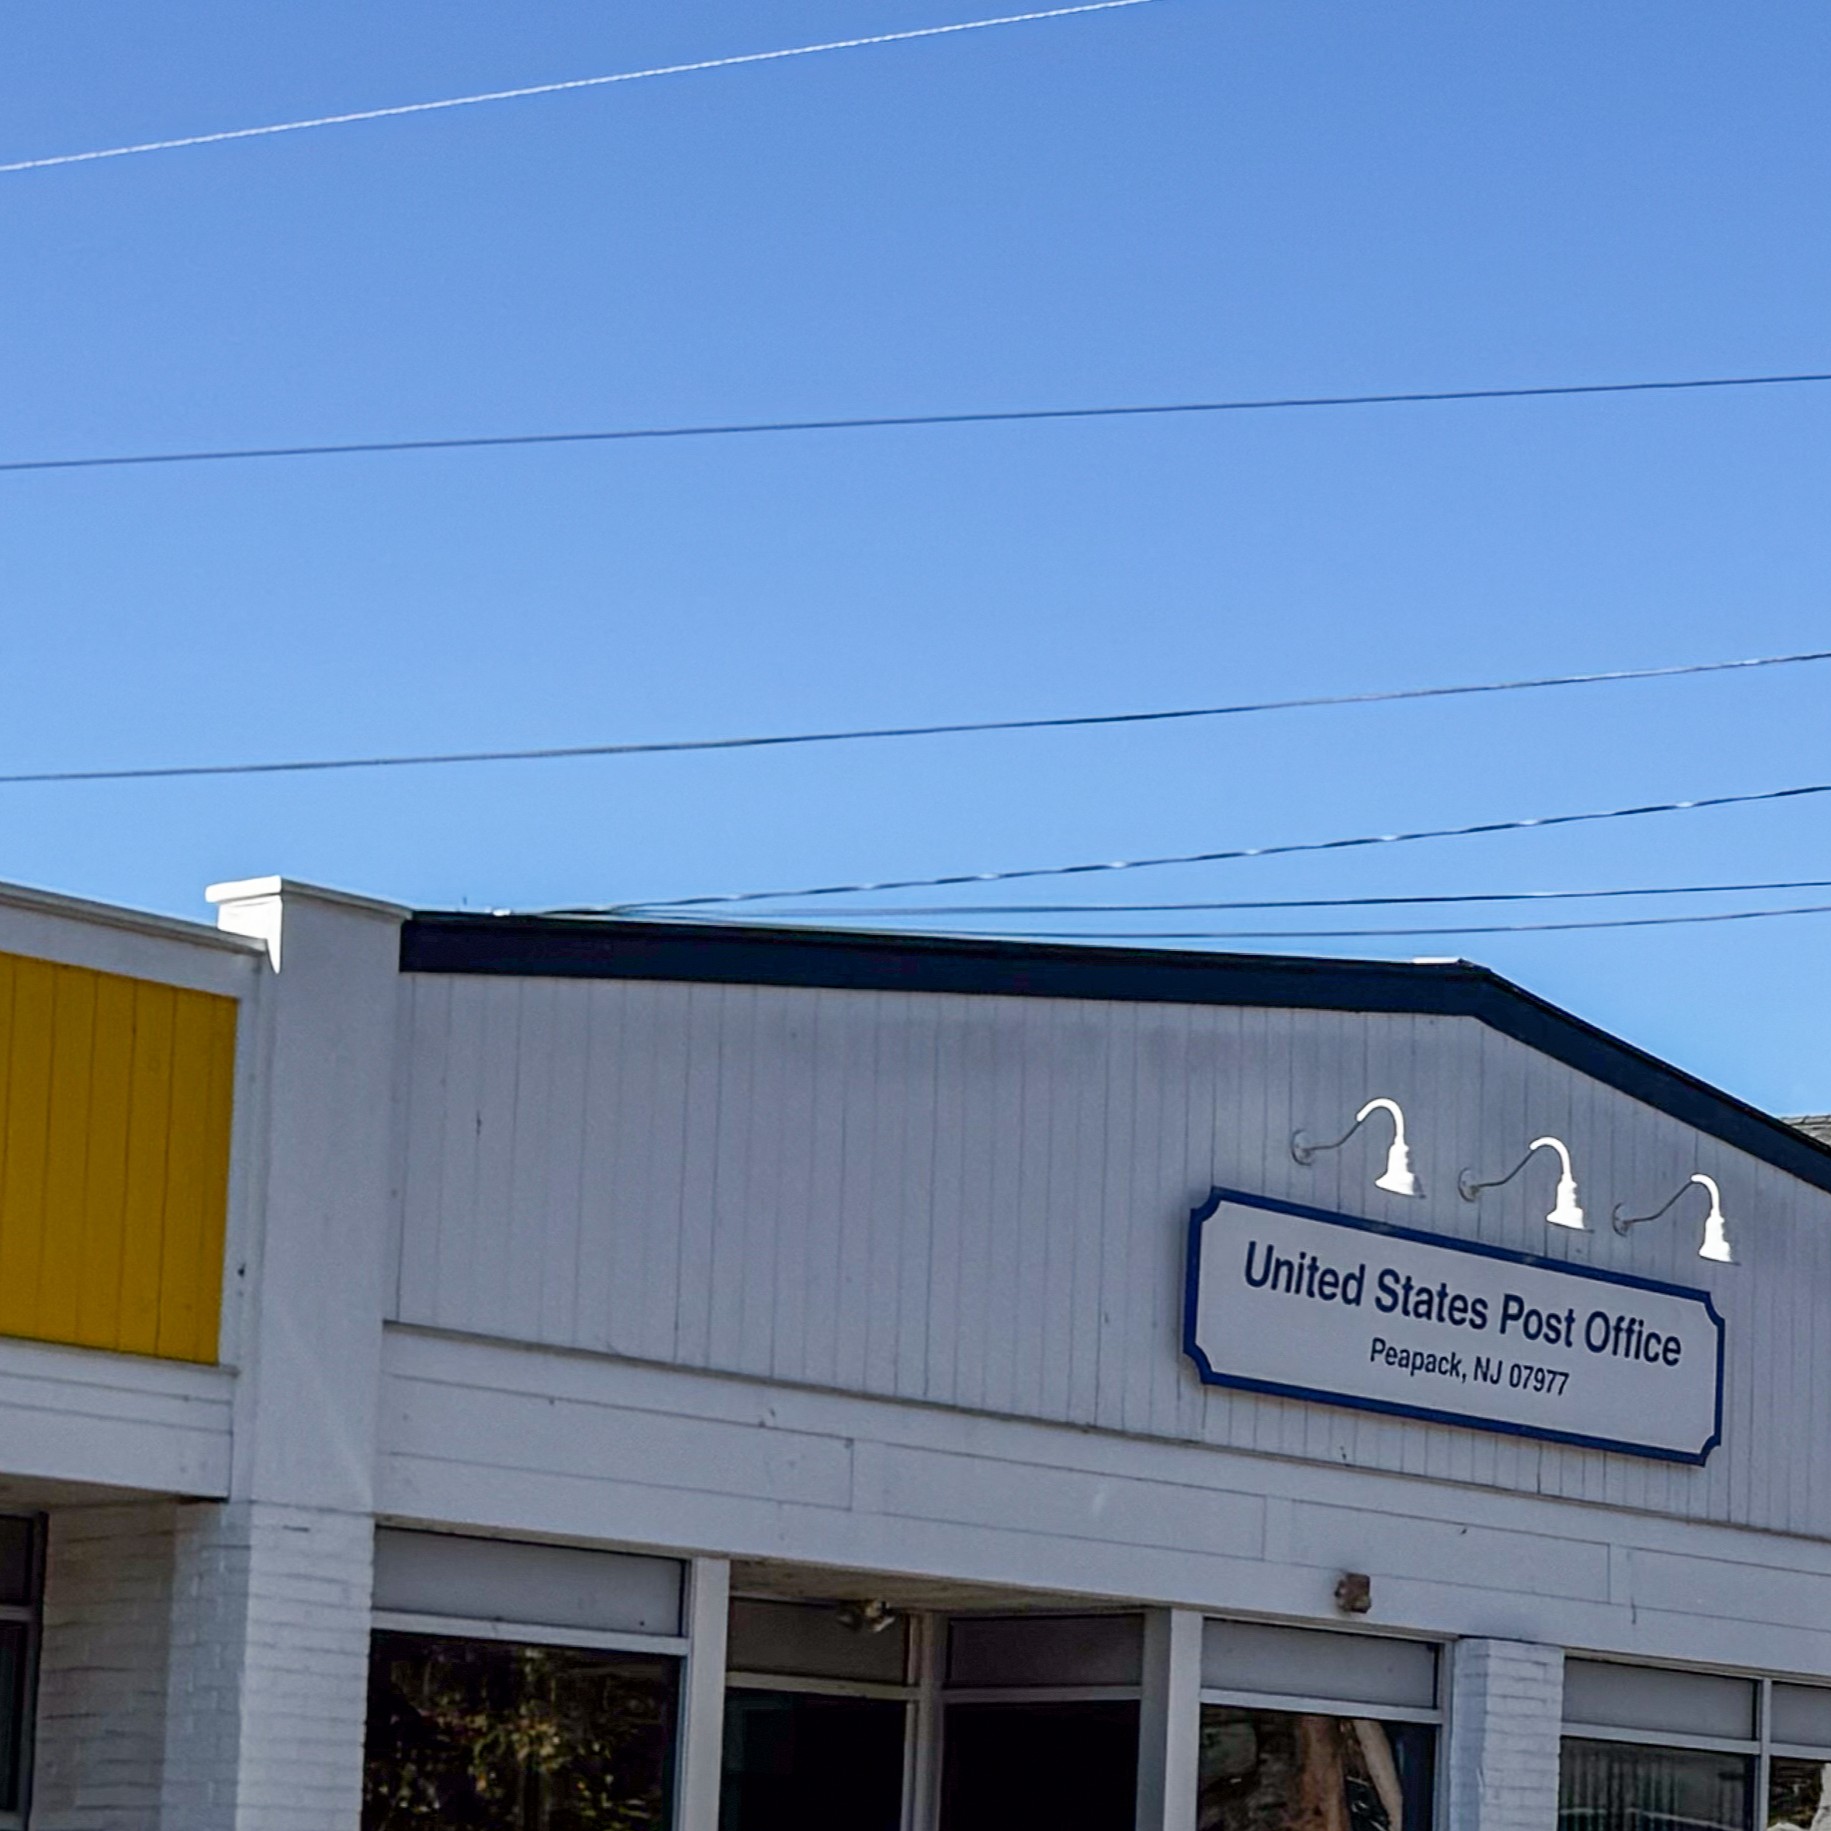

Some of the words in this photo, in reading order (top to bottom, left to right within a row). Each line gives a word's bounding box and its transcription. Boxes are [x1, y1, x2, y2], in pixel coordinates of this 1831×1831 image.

[1243, 1239, 1364, 1307] United
[1374, 1269, 1489, 1330] States
[1499, 1294, 1575, 1348] Post
[1585, 1311, 1682, 1367] Office
[1371, 1337, 1467, 1384] Peapack,
[1474, 1357, 1503, 1387] NJ
[1509, 1366, 1570, 1397] 07977
